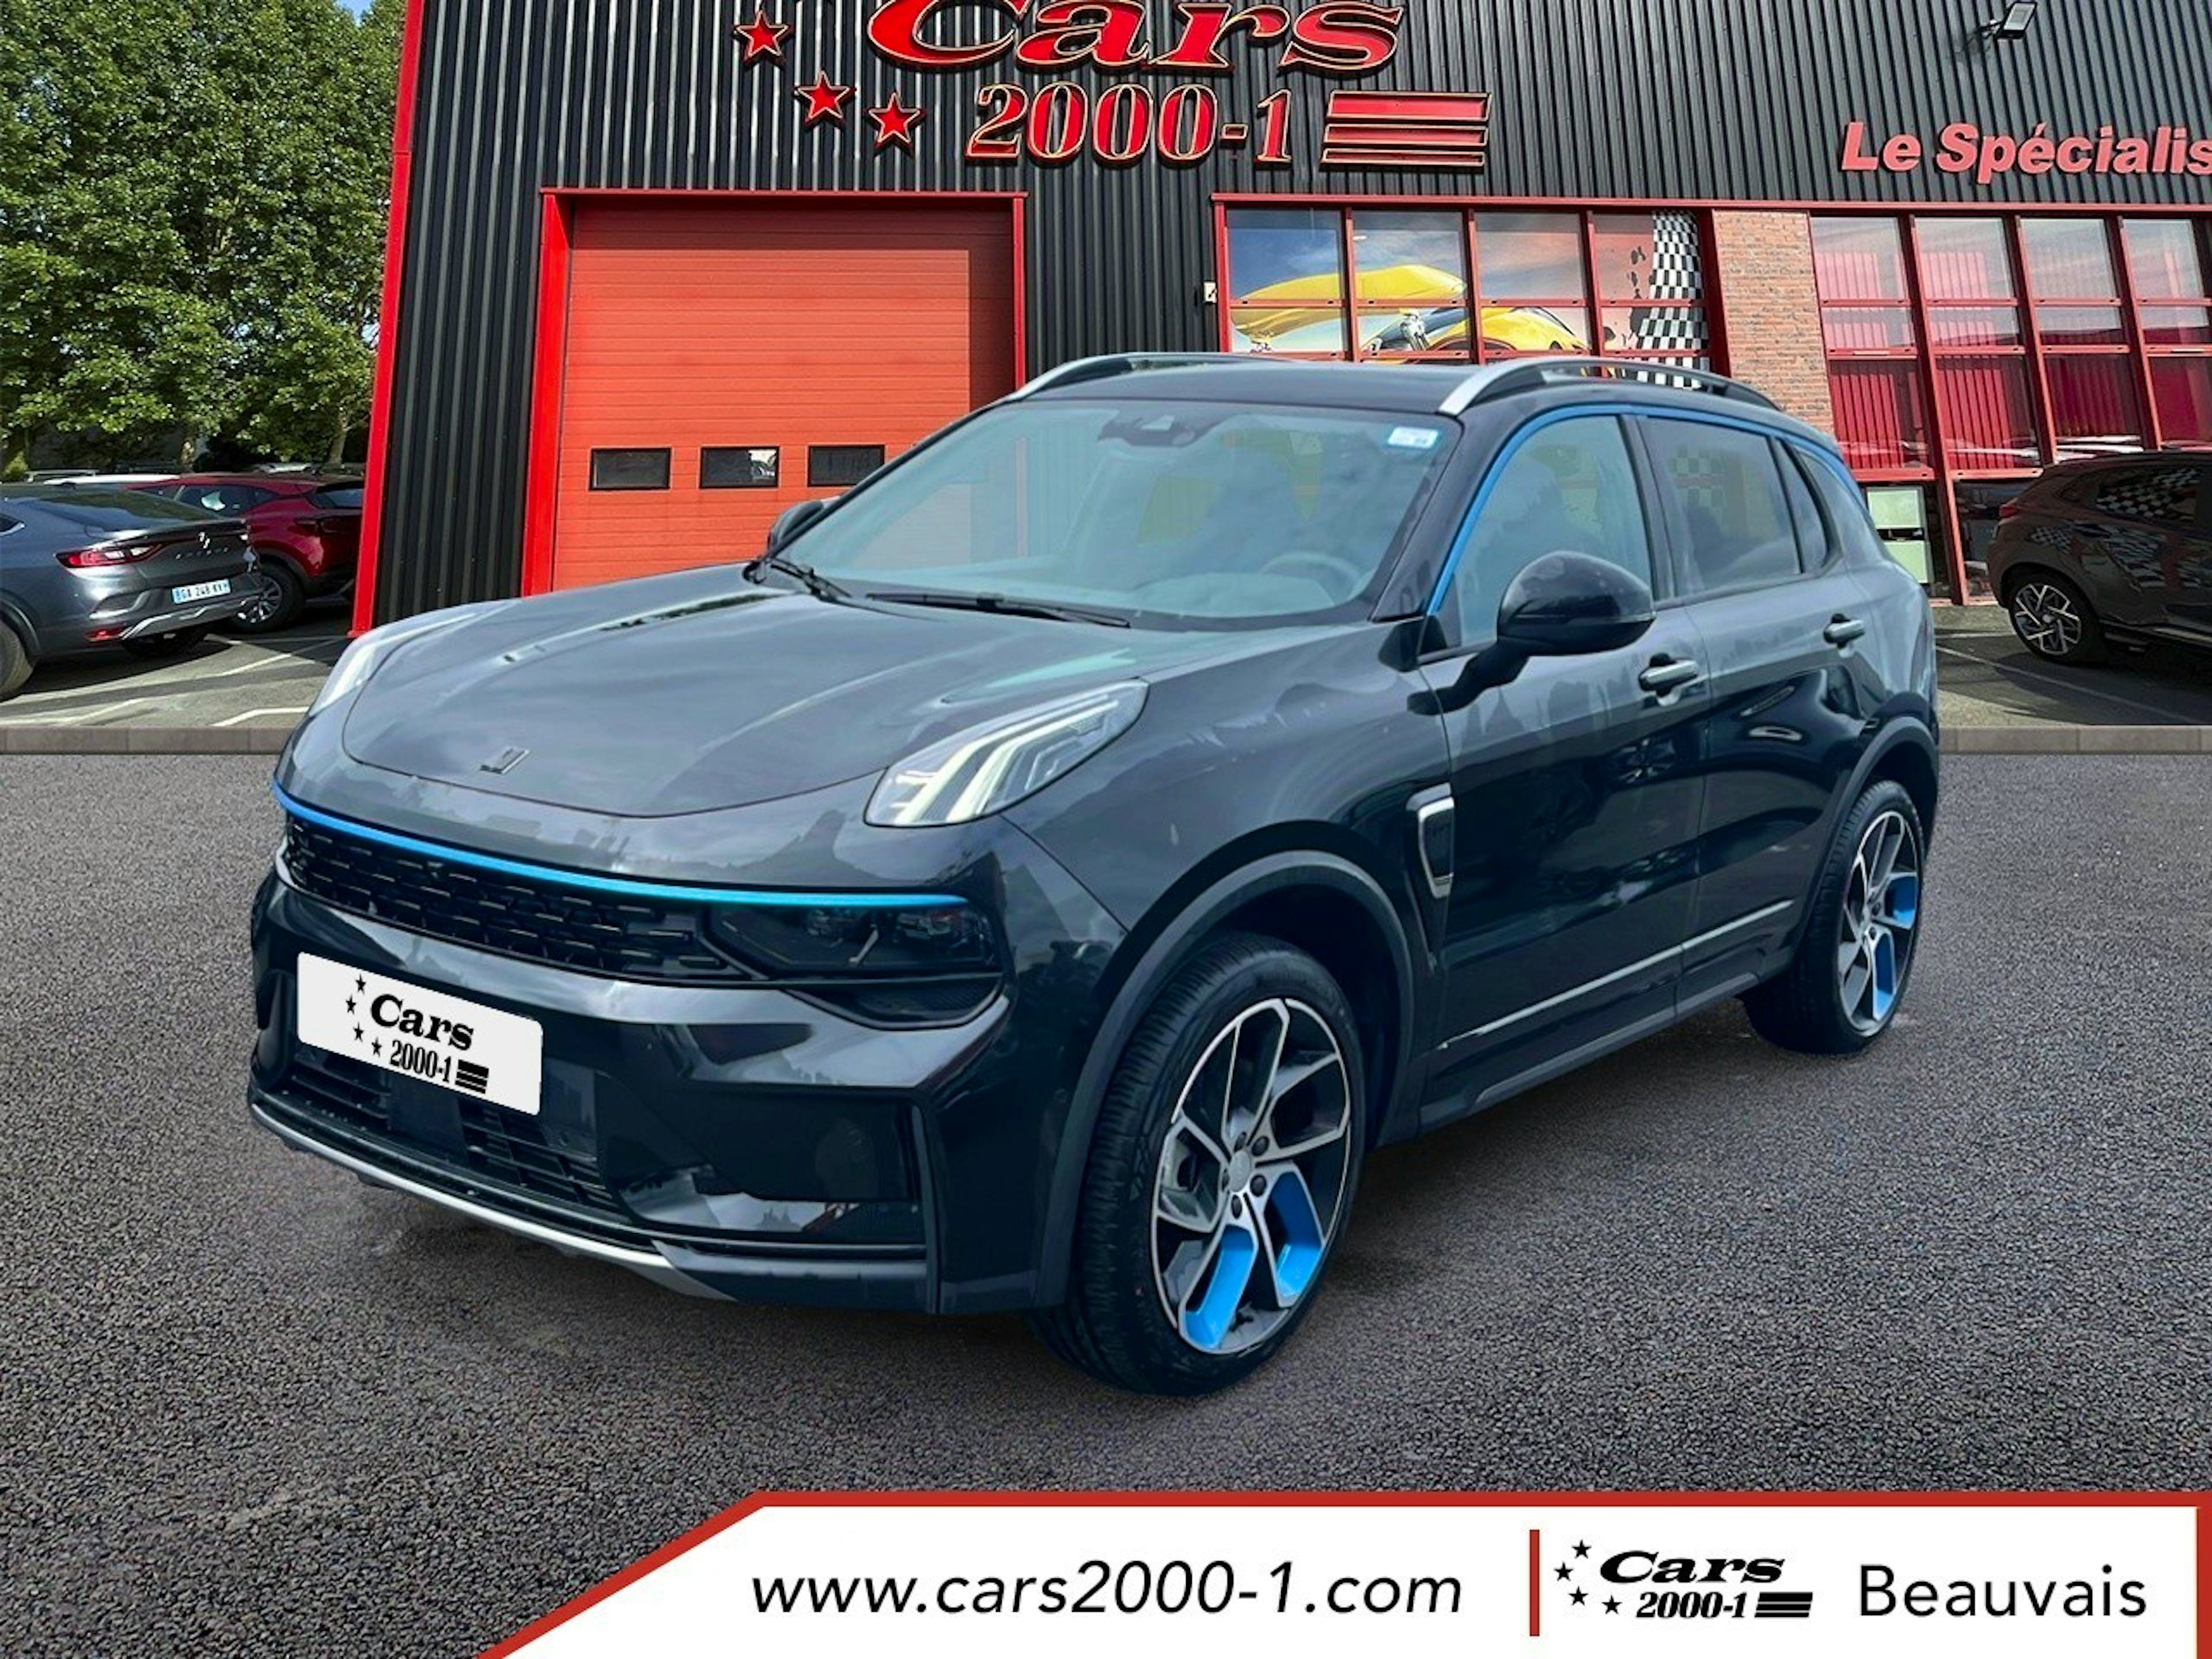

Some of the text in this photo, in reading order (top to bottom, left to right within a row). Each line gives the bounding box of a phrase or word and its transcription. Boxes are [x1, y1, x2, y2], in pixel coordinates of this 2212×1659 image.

[866, 0, 1404, 70] Cars
[964, 81, 1292, 165] 2000-1
[1842, 122, 2212, 184] Le Spécialis
[370, 994, 474, 1051] Cars
[389, 1039, 452, 1084] 2000-1
